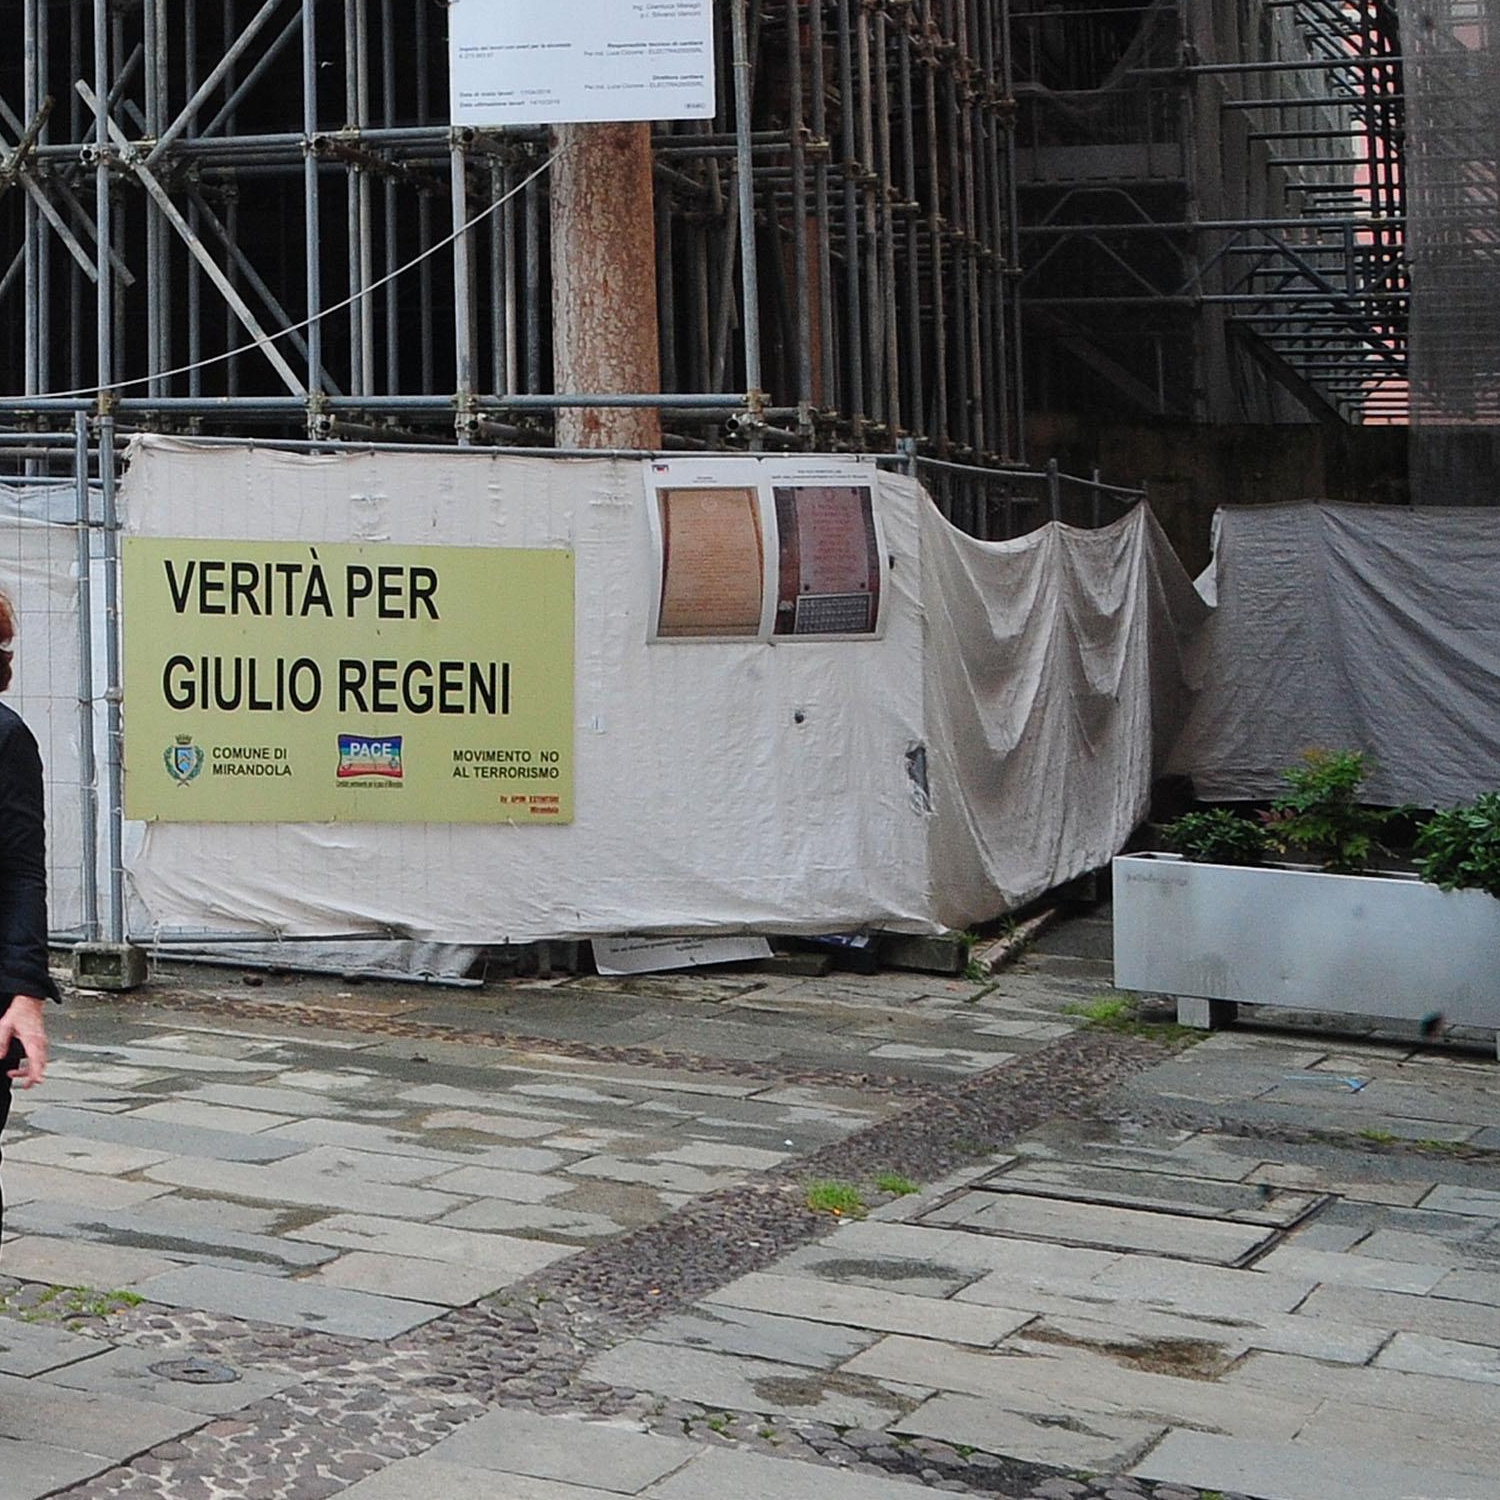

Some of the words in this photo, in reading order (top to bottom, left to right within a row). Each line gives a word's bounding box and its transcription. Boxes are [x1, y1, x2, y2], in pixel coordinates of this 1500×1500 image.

[164, 547, 334, 618] VERITÀ
[346, 565, 440, 620] PER
[162, 654, 322, 713] GIULIO
[338, 658, 510, 715] REGENI
[212, 747, 269, 760] COMUNE
[274, 748, 287, 759] DI
[350, 742, 392, 757] PACE
[453, 750, 532, 762] MOVIMENTO
[540, 751, 559, 763] NO
[212, 763, 292, 776] MIRANDOLA
[453, 767, 469, 778] AL
[473, 766, 559, 779] TERRORISMO
